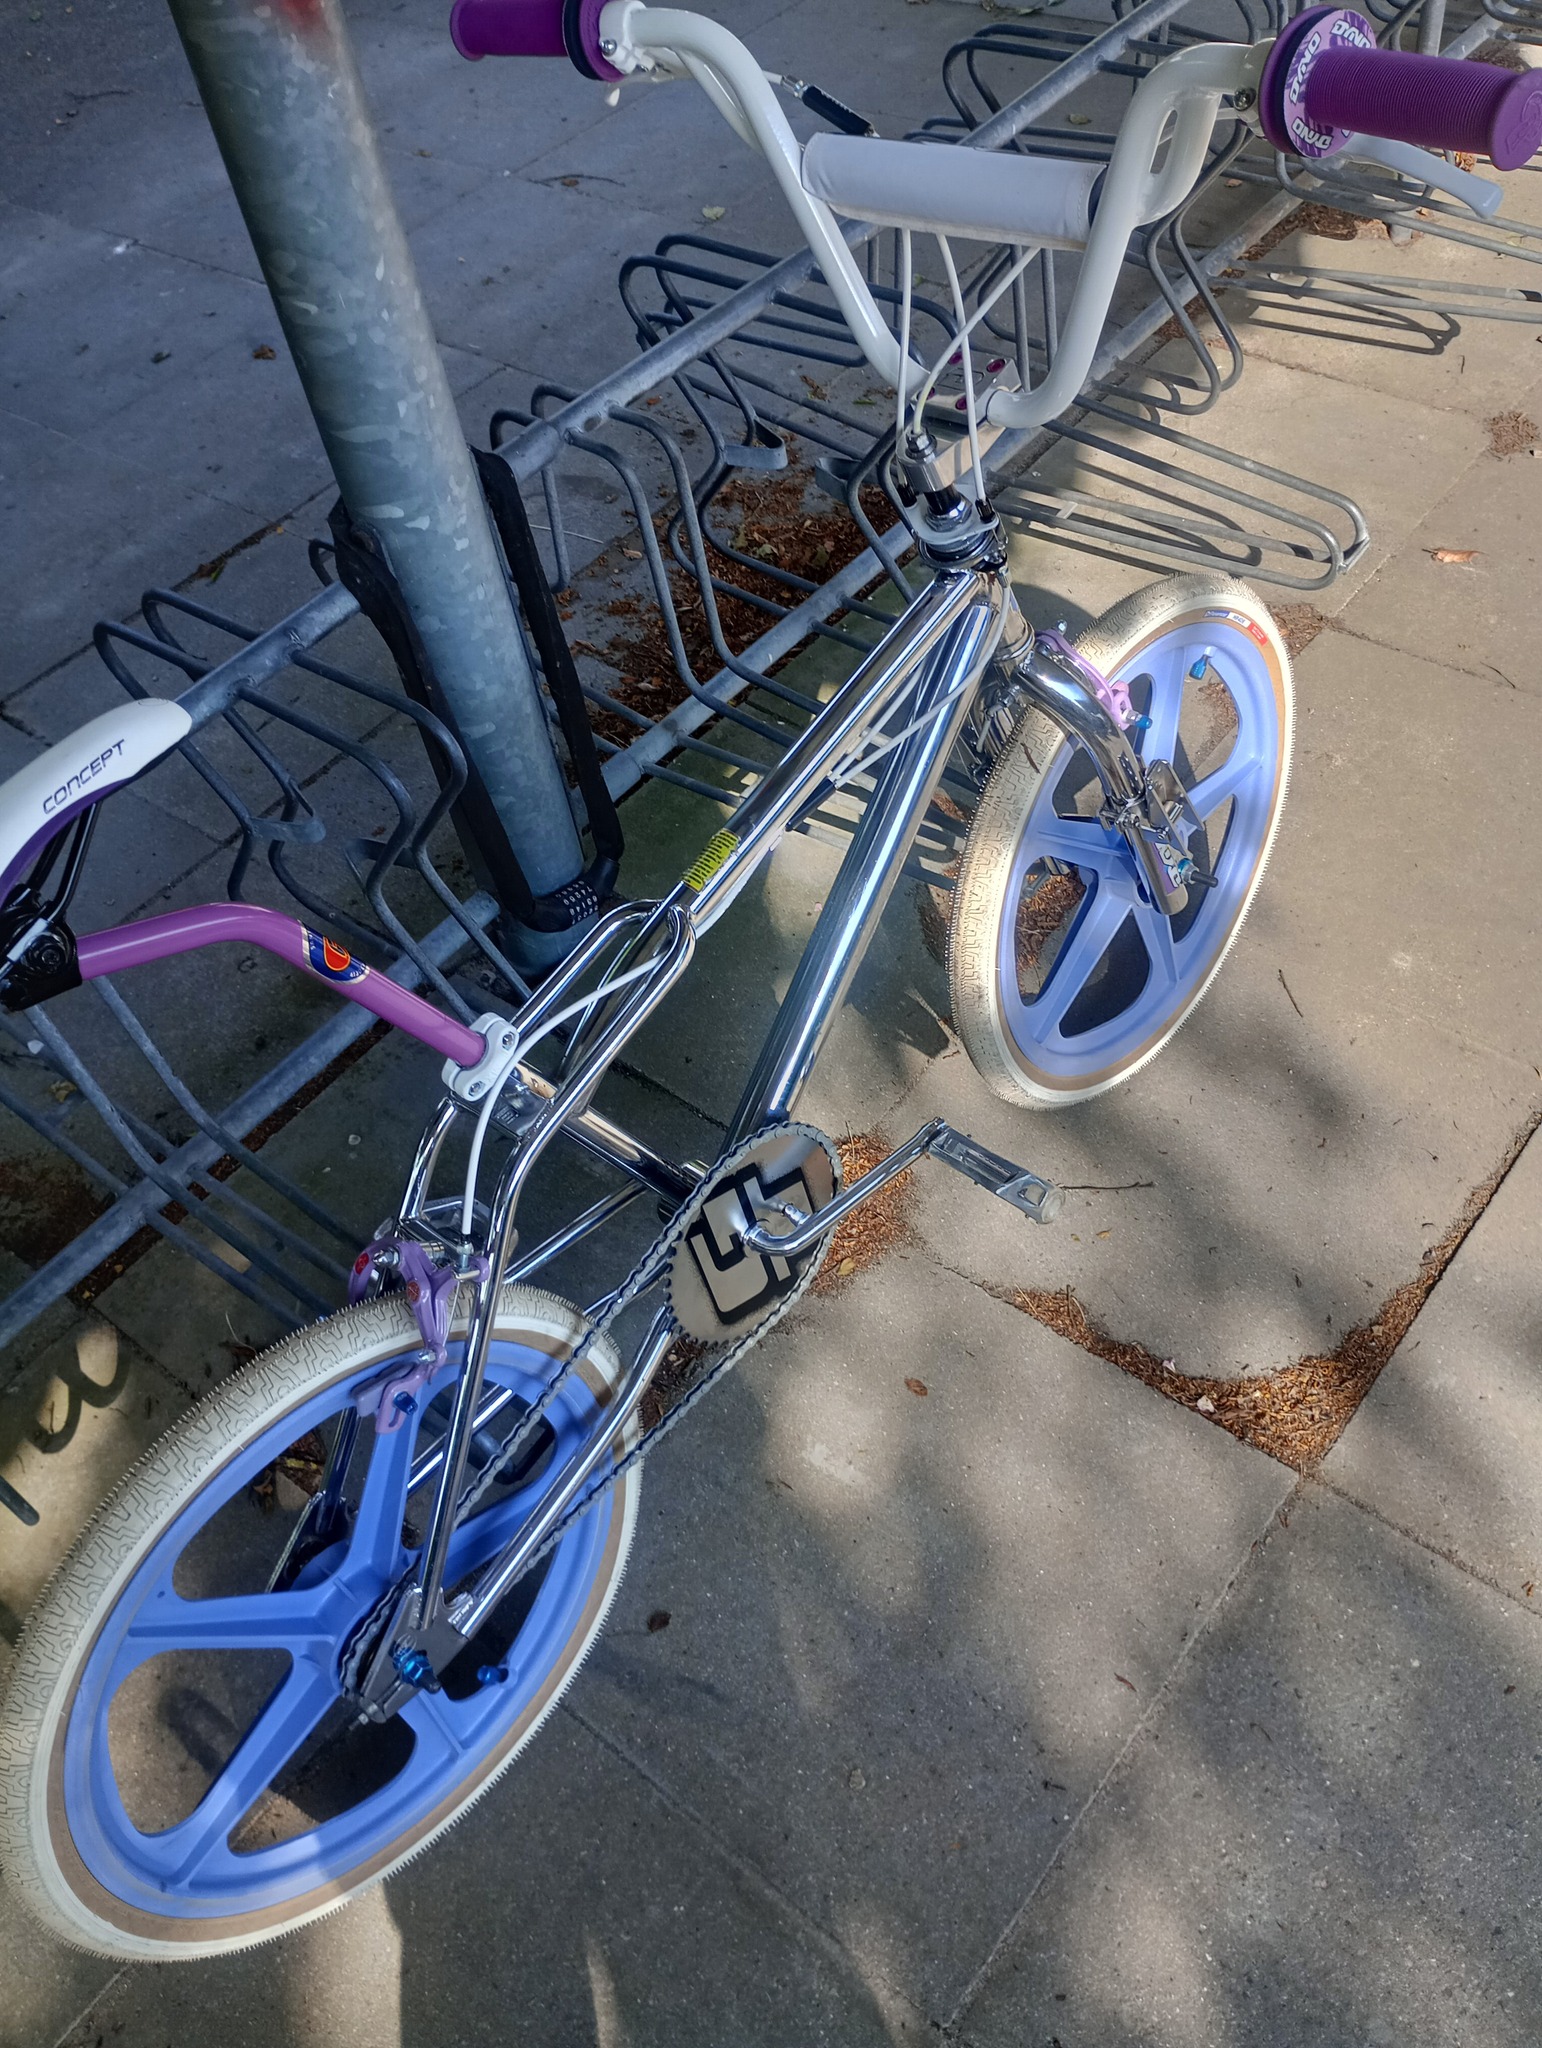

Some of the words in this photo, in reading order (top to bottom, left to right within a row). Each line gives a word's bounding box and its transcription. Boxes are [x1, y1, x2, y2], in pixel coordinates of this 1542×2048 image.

[1290, 31, 1321, 104] DYNO
[1292, 117, 1333, 150] DYNO
[43, 739, 124, 814] CONCEPT
